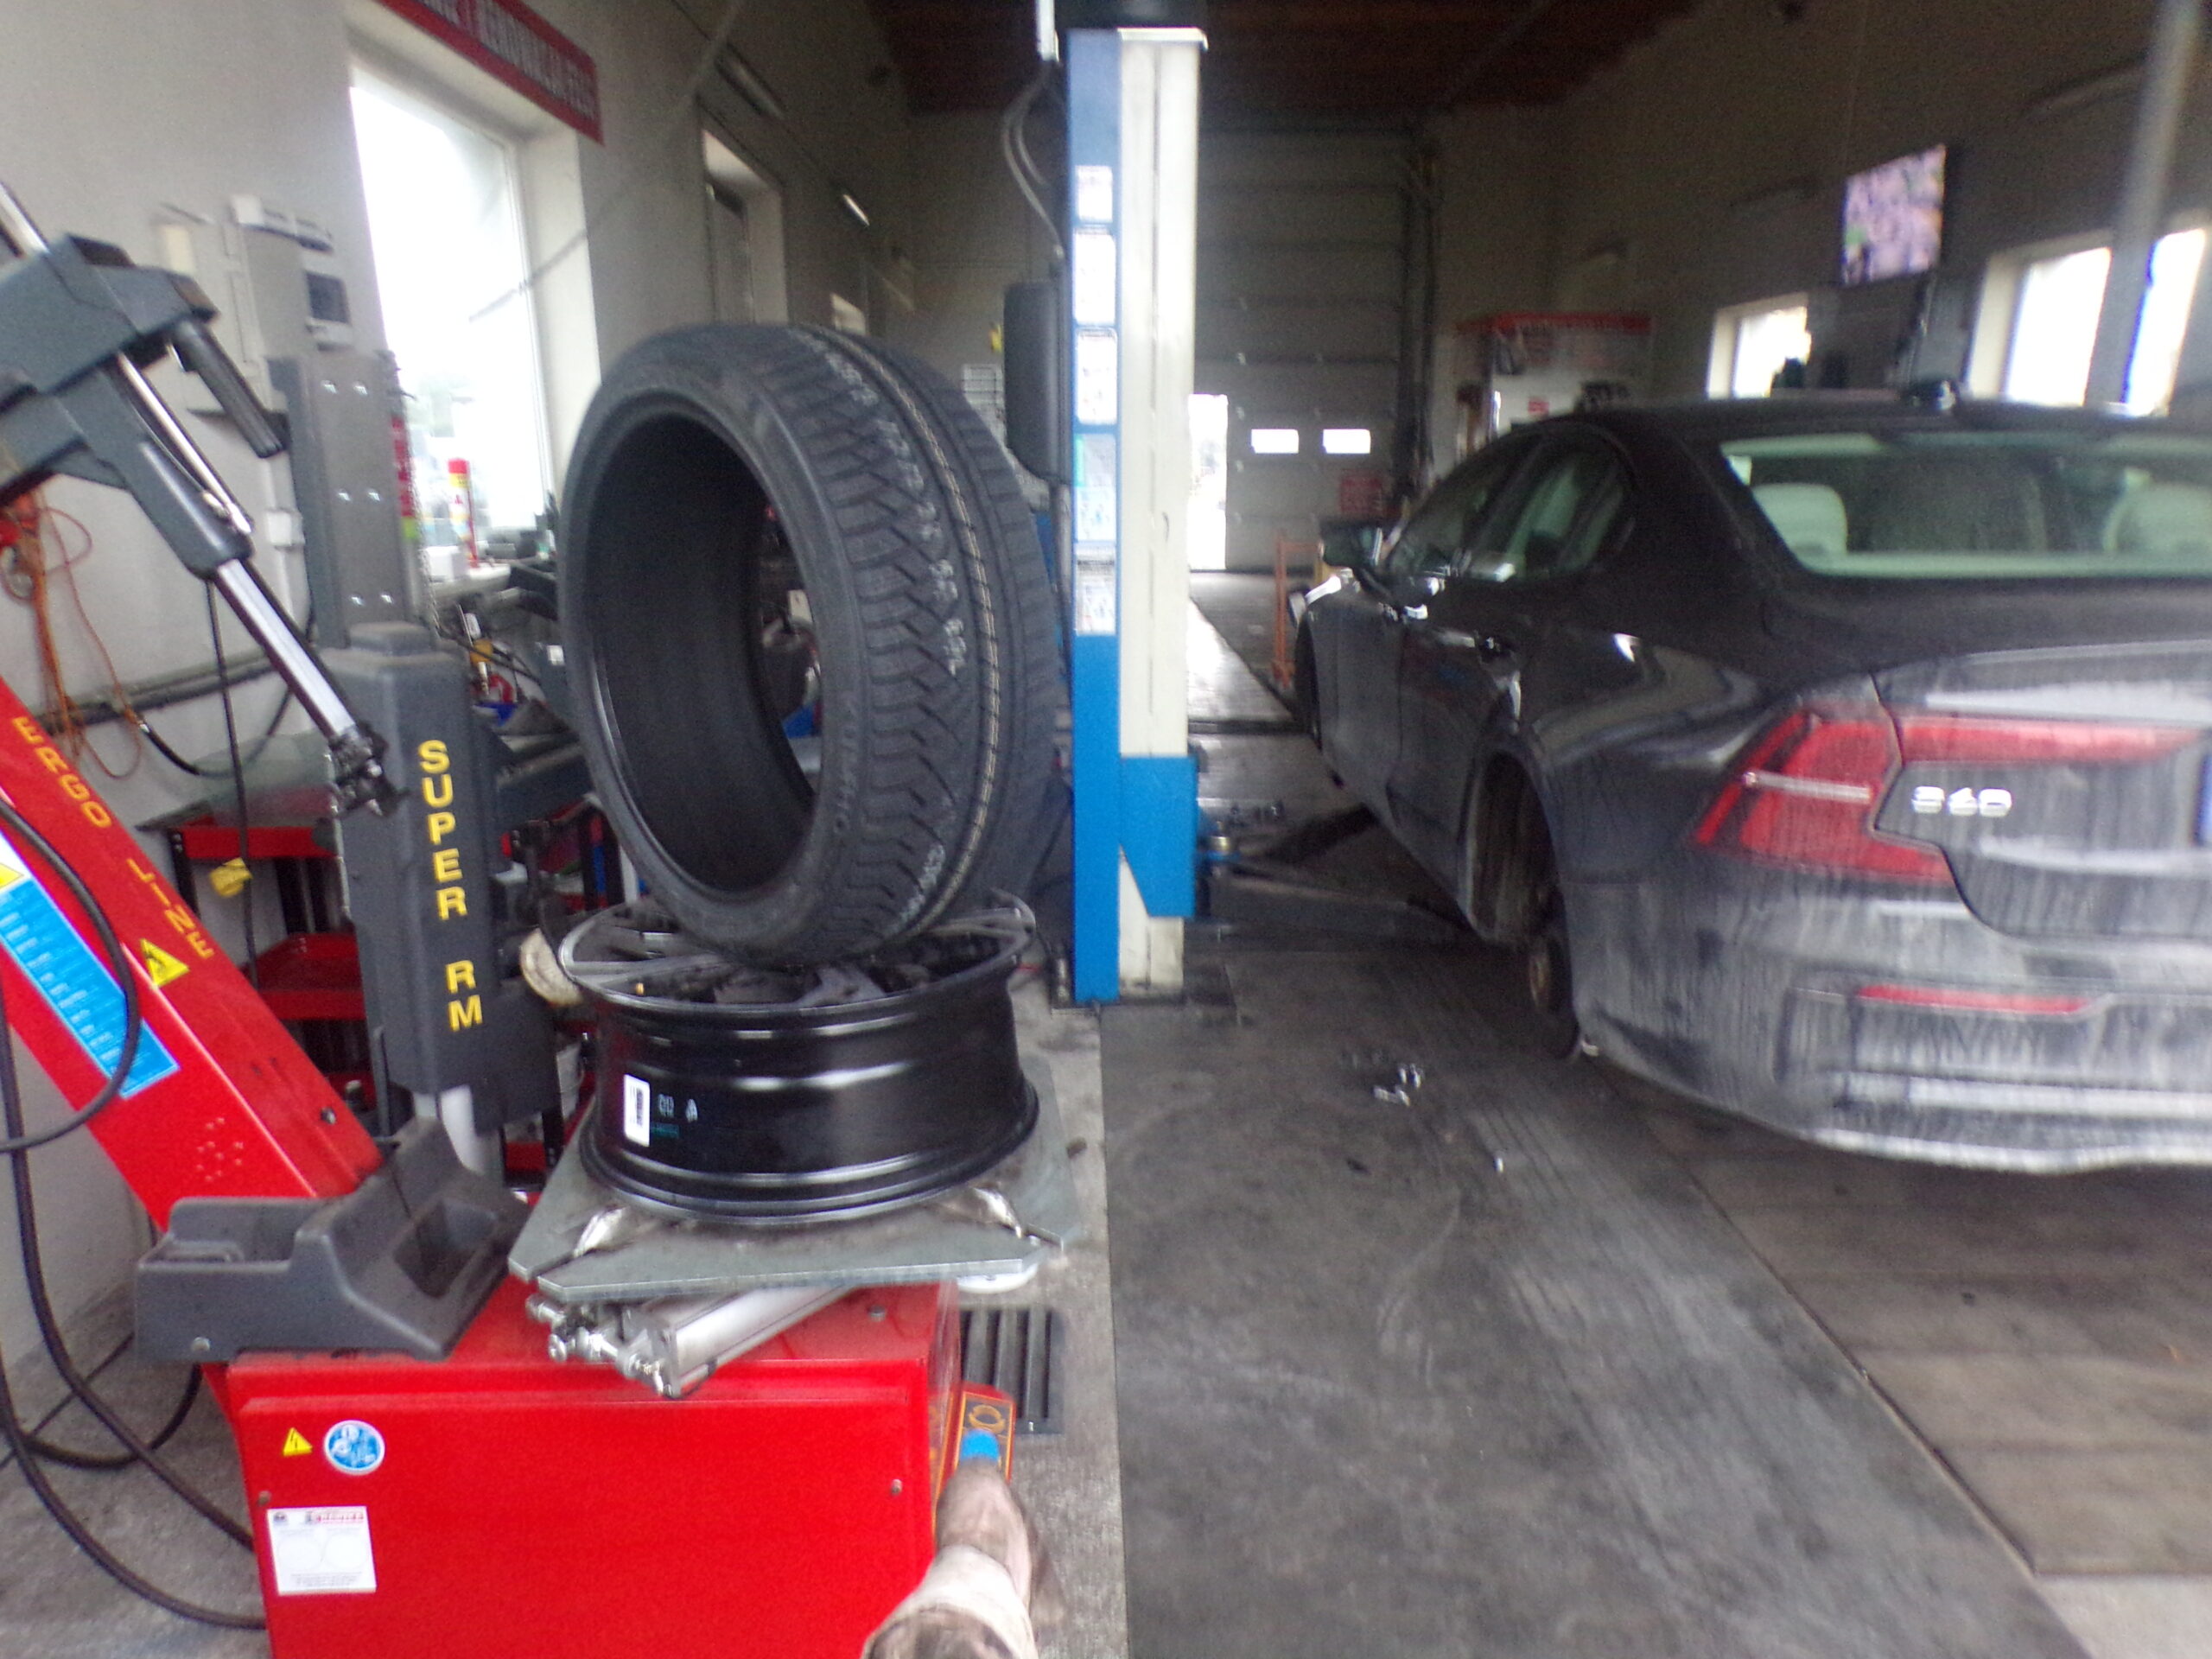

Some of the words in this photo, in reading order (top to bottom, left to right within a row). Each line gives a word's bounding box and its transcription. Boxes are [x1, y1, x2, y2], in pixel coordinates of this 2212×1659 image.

[12, 716, 112, 828] ERGO
[127, 858, 214, 959] LINE
[418, 739, 468, 920] SUPER
[446, 959, 484, 1033] RM
